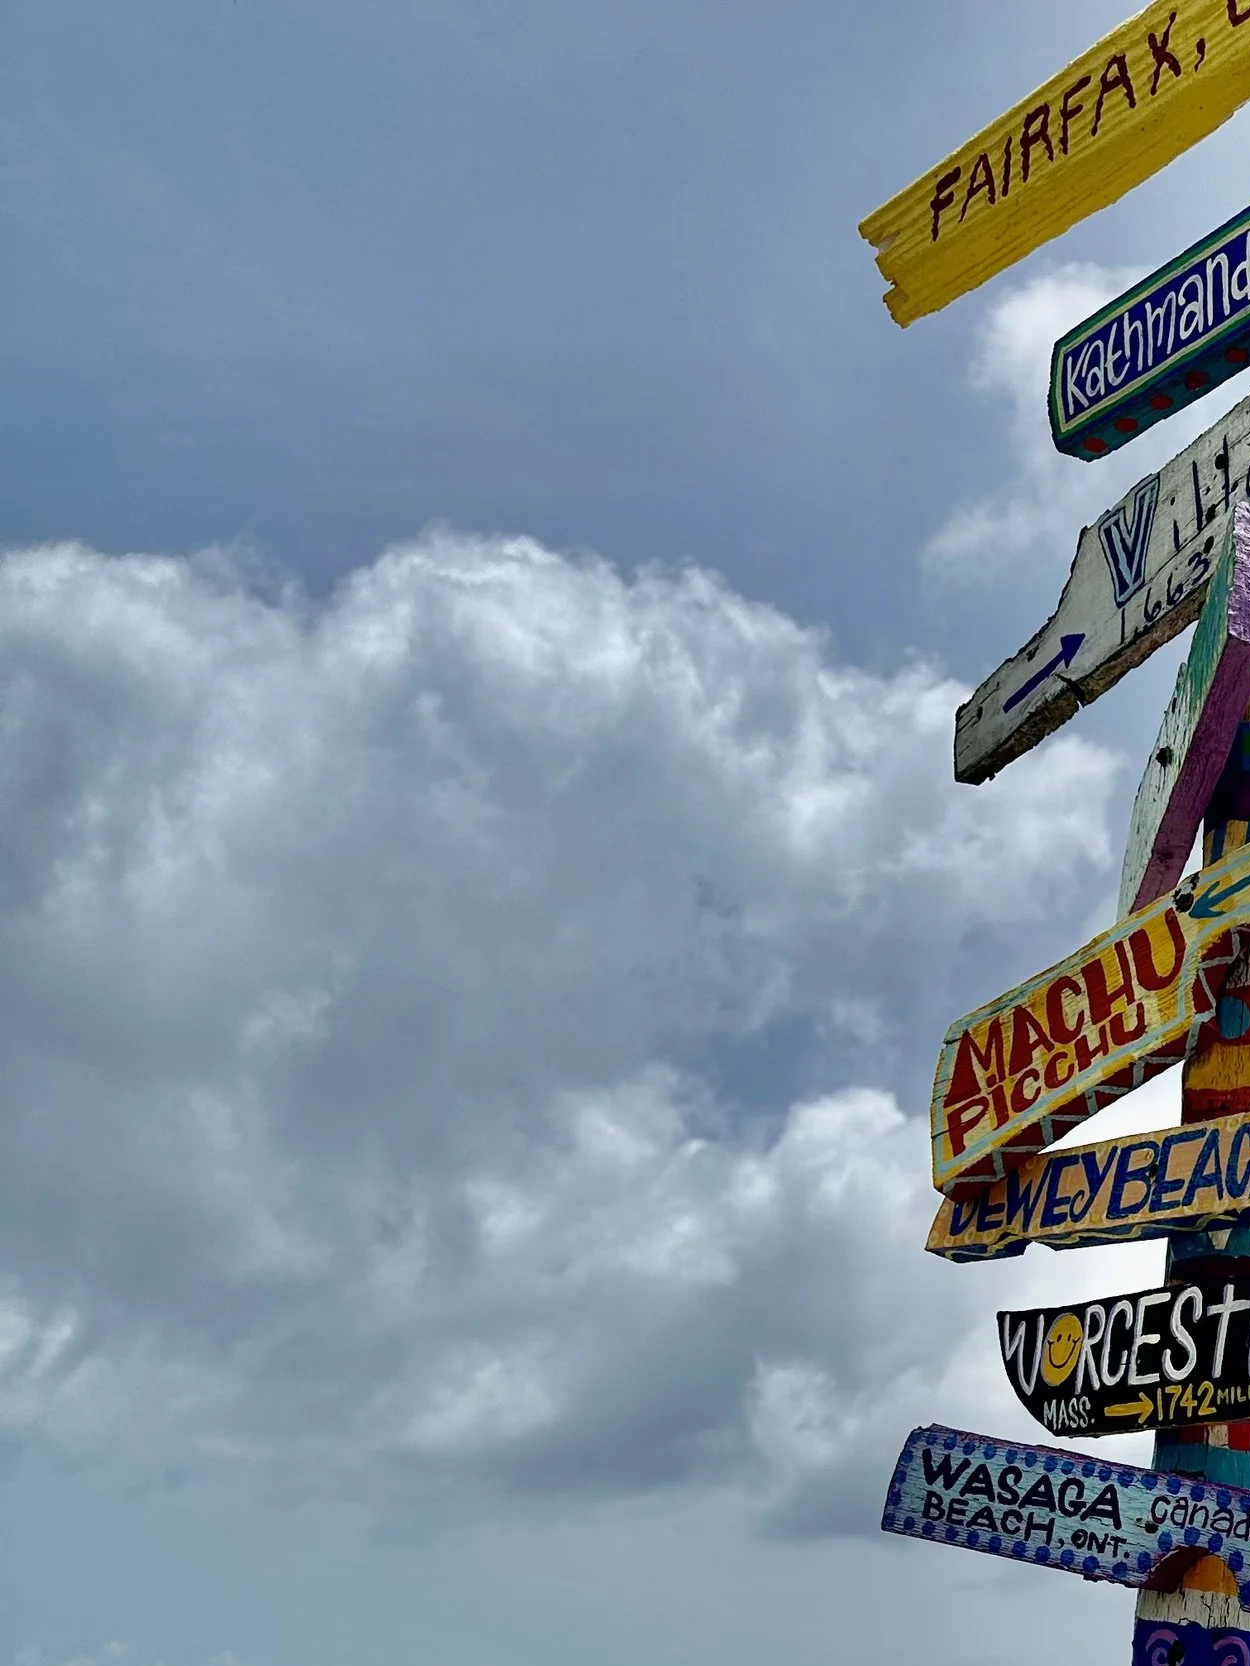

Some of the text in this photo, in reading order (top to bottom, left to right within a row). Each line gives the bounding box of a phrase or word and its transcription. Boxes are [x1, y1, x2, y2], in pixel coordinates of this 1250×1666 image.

[1119, 551, 1210, 645] 1663
[943, 907, 1187, 1108] MACHU
[1043, 1396, 1096, 1430] MASS.
[1157, 1381, 1217, 1422] 1742
[921, 1448, 1123, 1530] WASAGA
[1072, 1528, 1131, 1559] ONT.
